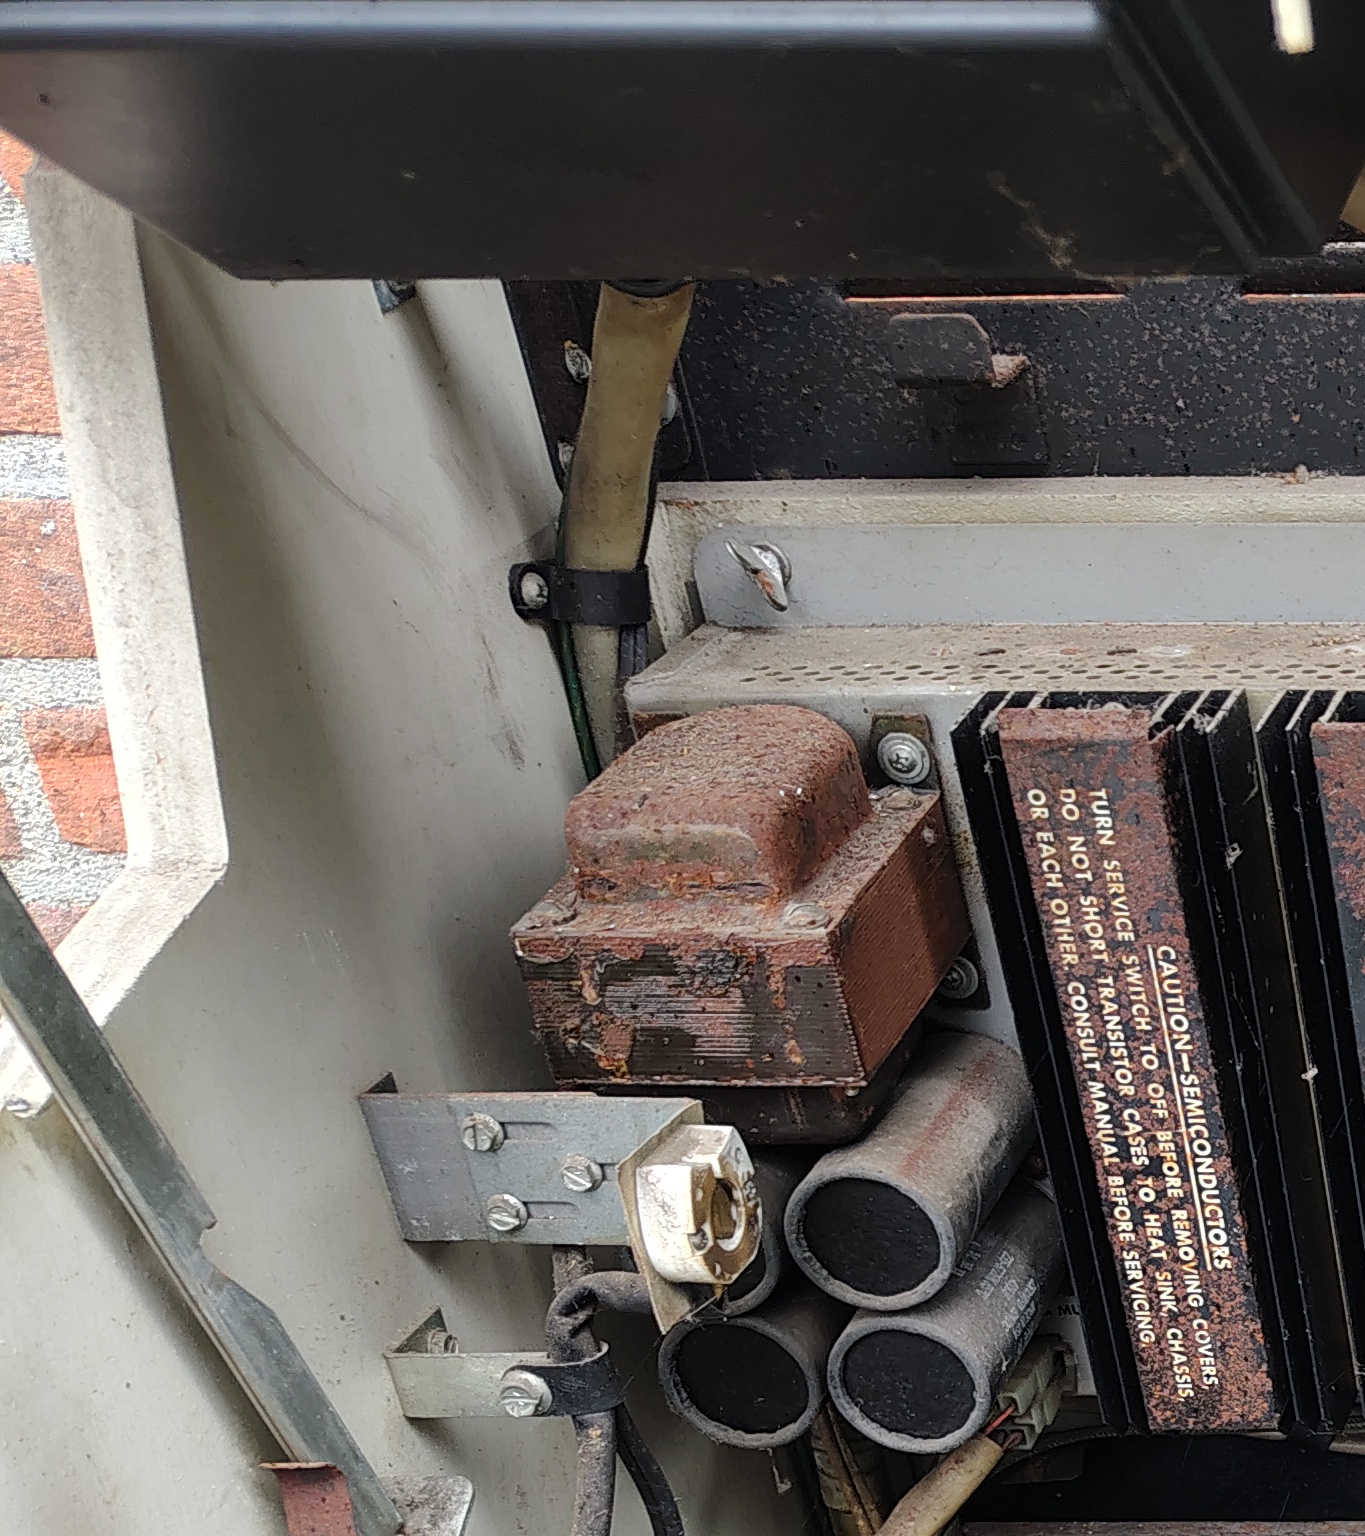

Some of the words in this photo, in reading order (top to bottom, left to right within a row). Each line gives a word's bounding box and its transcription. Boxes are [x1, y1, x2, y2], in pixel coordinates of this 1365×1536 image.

[1027, 788, 1049, 820] OR
[1059, 788, 1080, 821] DO
[1088, 787, 1117, 846] TURN
[1035, 831, 1064, 888] EACH
[1066, 835, 1093, 882] NOT
[1050, 898, 1080, 971] OTHER.
[1079, 895, 1110, 963] SHORT
[1103, 859, 1136, 942] SERVICE
[1067, 981, 1101, 1072] CONSULT
[1121, 955, 1152, 1031] SWITCH
[1096, 975, 1136, 1097] TRANSISTOR
[1139, 1043, 1159, 1070] TO
[1087, 1080, 1120, 1167] MANUAL
[1147, 1083, 1169, 1120] OFF
[1122, 1108, 1150, 1166] CASES
[1155, 1130, 1184, 1198] BEFORE
[1107, 1175, 1136, 1243] BEFORE
[1136, 1177, 1156, 1202] TO
[1143, 1213, 1168, 1261] HEAT
[1170, 1209, 1204, 1307] REMOVING
[1122, 1250, 1156, 1348] SERVICING.
[1154, 1271, 1178, 1317] SINK,
[1166, 1328, 1195, 1402] CHASSIS,
[1192, 1318, 1219, 1390] COVERS,
